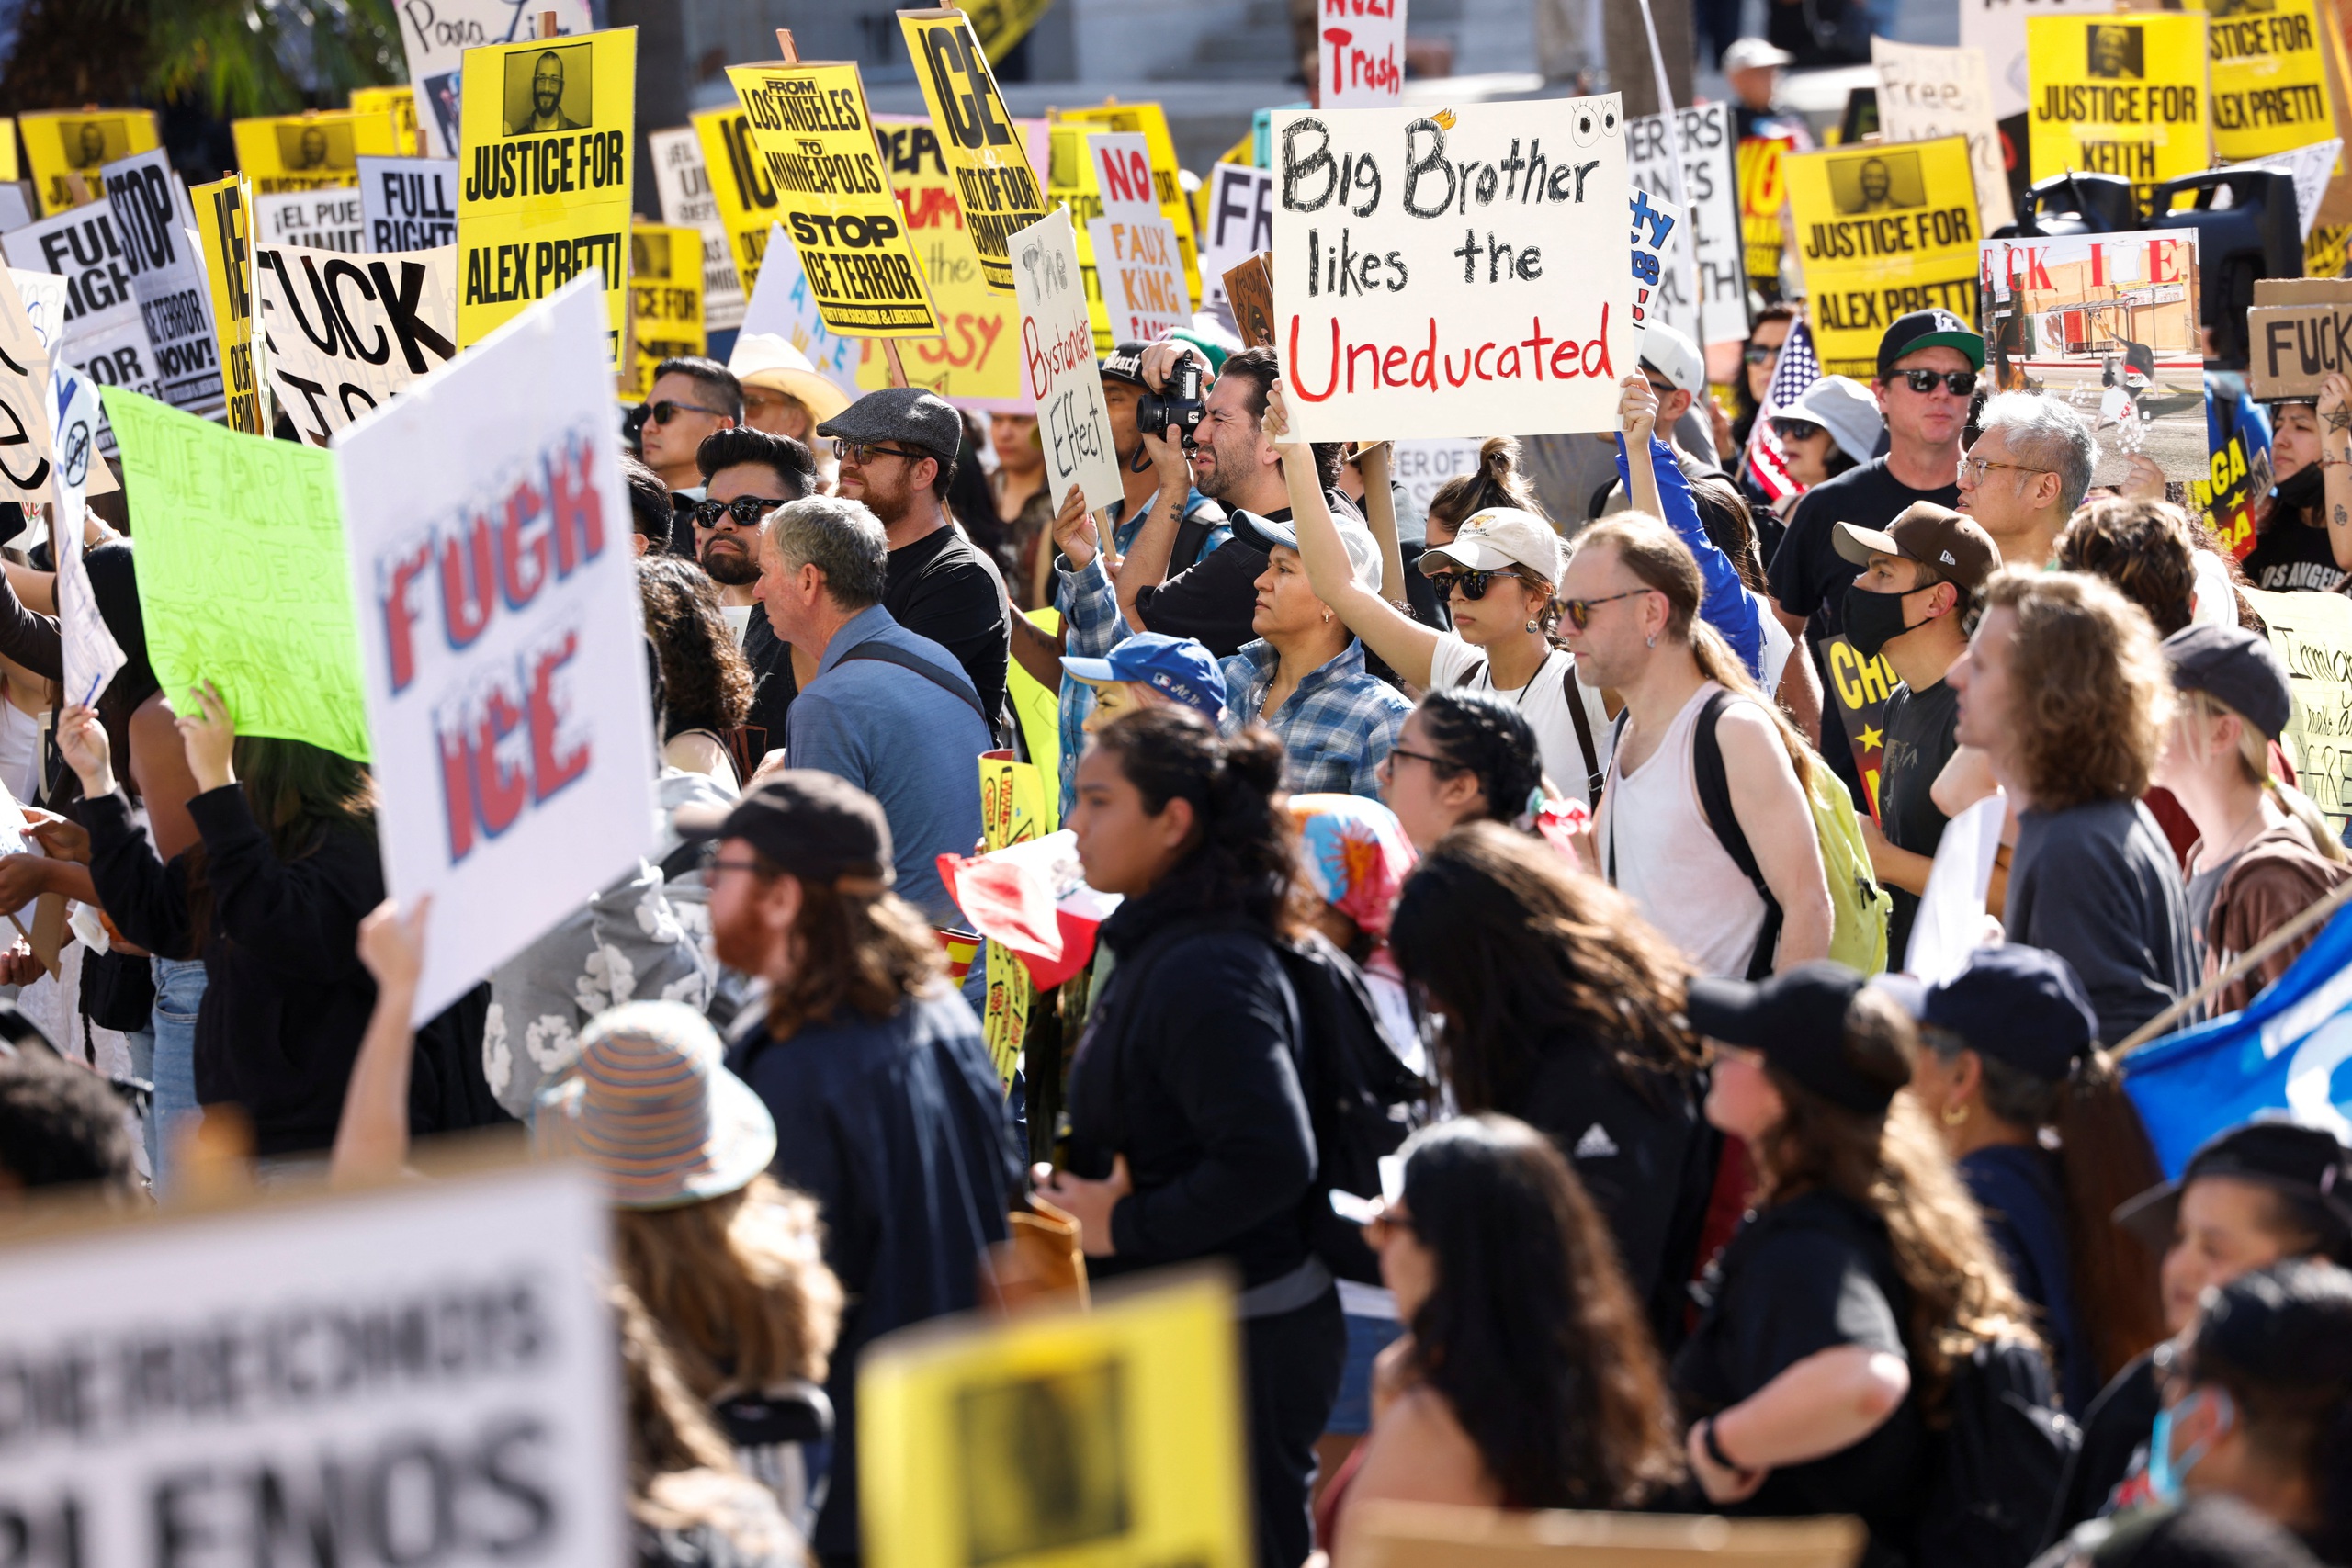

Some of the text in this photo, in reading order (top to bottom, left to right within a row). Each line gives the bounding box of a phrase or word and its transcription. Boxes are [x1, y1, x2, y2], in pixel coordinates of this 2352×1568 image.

[1323, 28, 1399, 96] Trash
[2210, 14, 2313, 61] STICE FOR
[741, 88, 861, 132] LOS ANGELES
[765, 80, 816, 96] FROM
[917, 26, 1012, 150] ICE
[2038, 85, 2197, 125] JUSTICE FOR
[2250, 85, 2324, 128] PRETTI
[466, 130, 624, 202] JUSTICE FOR
[765, 152, 882, 194] MINNEAPOLIS
[798, 141, 822, 155] TO
[1283, 116, 1600, 220] Big Brother
[382, 172, 455, 219] FULL
[1100, 148, 1151, 203] NO
[107, 164, 175, 276] STOP
[316, 199, 360, 225] PUE
[789, 211, 899, 248] STOP
[1806, 208, 1973, 260] JUSTICE FOR
[40, 215, 121, 276] FUL
[466, 232, 622, 306] ALEX PRETTI
[922, 241, 976, 286] the
[1022, 234, 1068, 306] The
[1111, 223, 1171, 266] FAUX
[1309, 227, 1408, 298] likes
[1453, 228, 1544, 284] the
[1982, 239, 2180, 292] FCK IE
[800, 250, 840, 299] ICE
[829, 254, 922, 300] TERROR
[1120, 268, 1182, 315] KING
[153, 289, 207, 343] TERROR
[880, 309, 892, 325] &
[889, 309, 931, 325] LIBERATION
[1819, 289, 1882, 332] ALEX
[154, 337, 216, 378] NOW!
[1023, 310, 1091, 400] Bystander
[1289, 301, 1615, 402] Uneducated
[1050, 383, 1104, 479] Effect
[375, 418, 606, 698] FUCK
[432, 611, 594, 868] ICE
